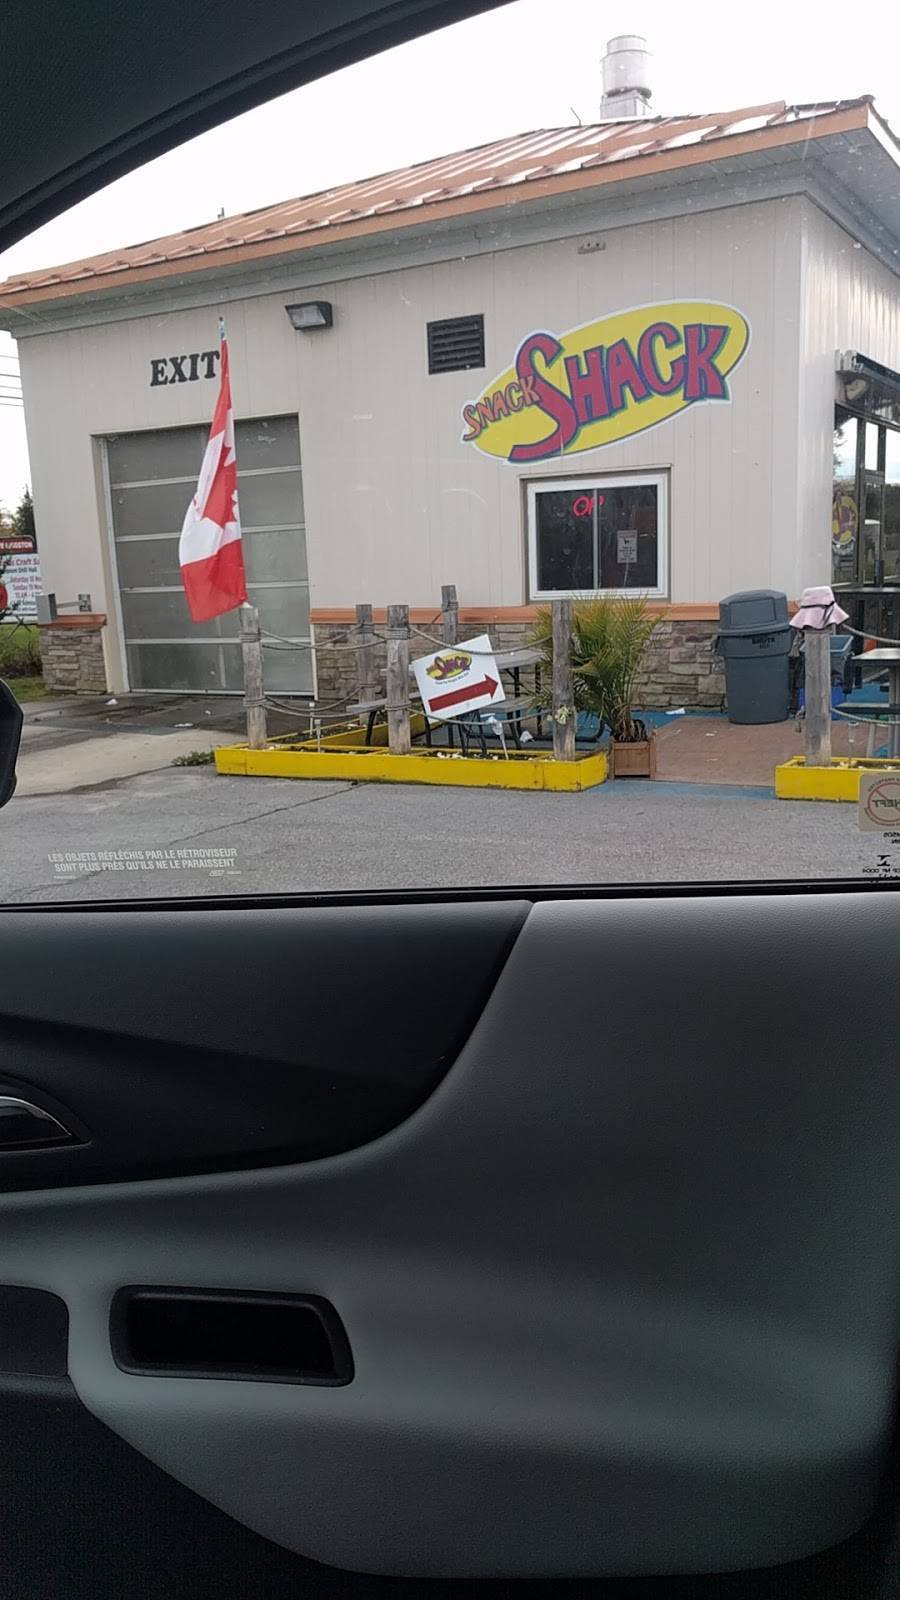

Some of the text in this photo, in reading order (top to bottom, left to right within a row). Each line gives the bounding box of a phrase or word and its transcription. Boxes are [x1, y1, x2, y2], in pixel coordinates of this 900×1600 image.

[150, 350, 220, 387] EXIT
[462, 322, 731, 463] SNACK SHACK
[47, 853, 64, 863] LES
[65, 852, 97, 862] OBJETS
[145, 850, 163, 860] PAR
[164, 849, 176, 859] LE
[176, 847, 238, 859] RÉTROVISEUR
[54, 862, 77, 872] SONT
[79, 861, 101, 872] PLUS
[126, 860, 155, 871] QU'ILS
[155, 860, 169, 870] NE
[169, 859, 181, 869] LE
[181, 858, 236, 869] PARAISSENT
